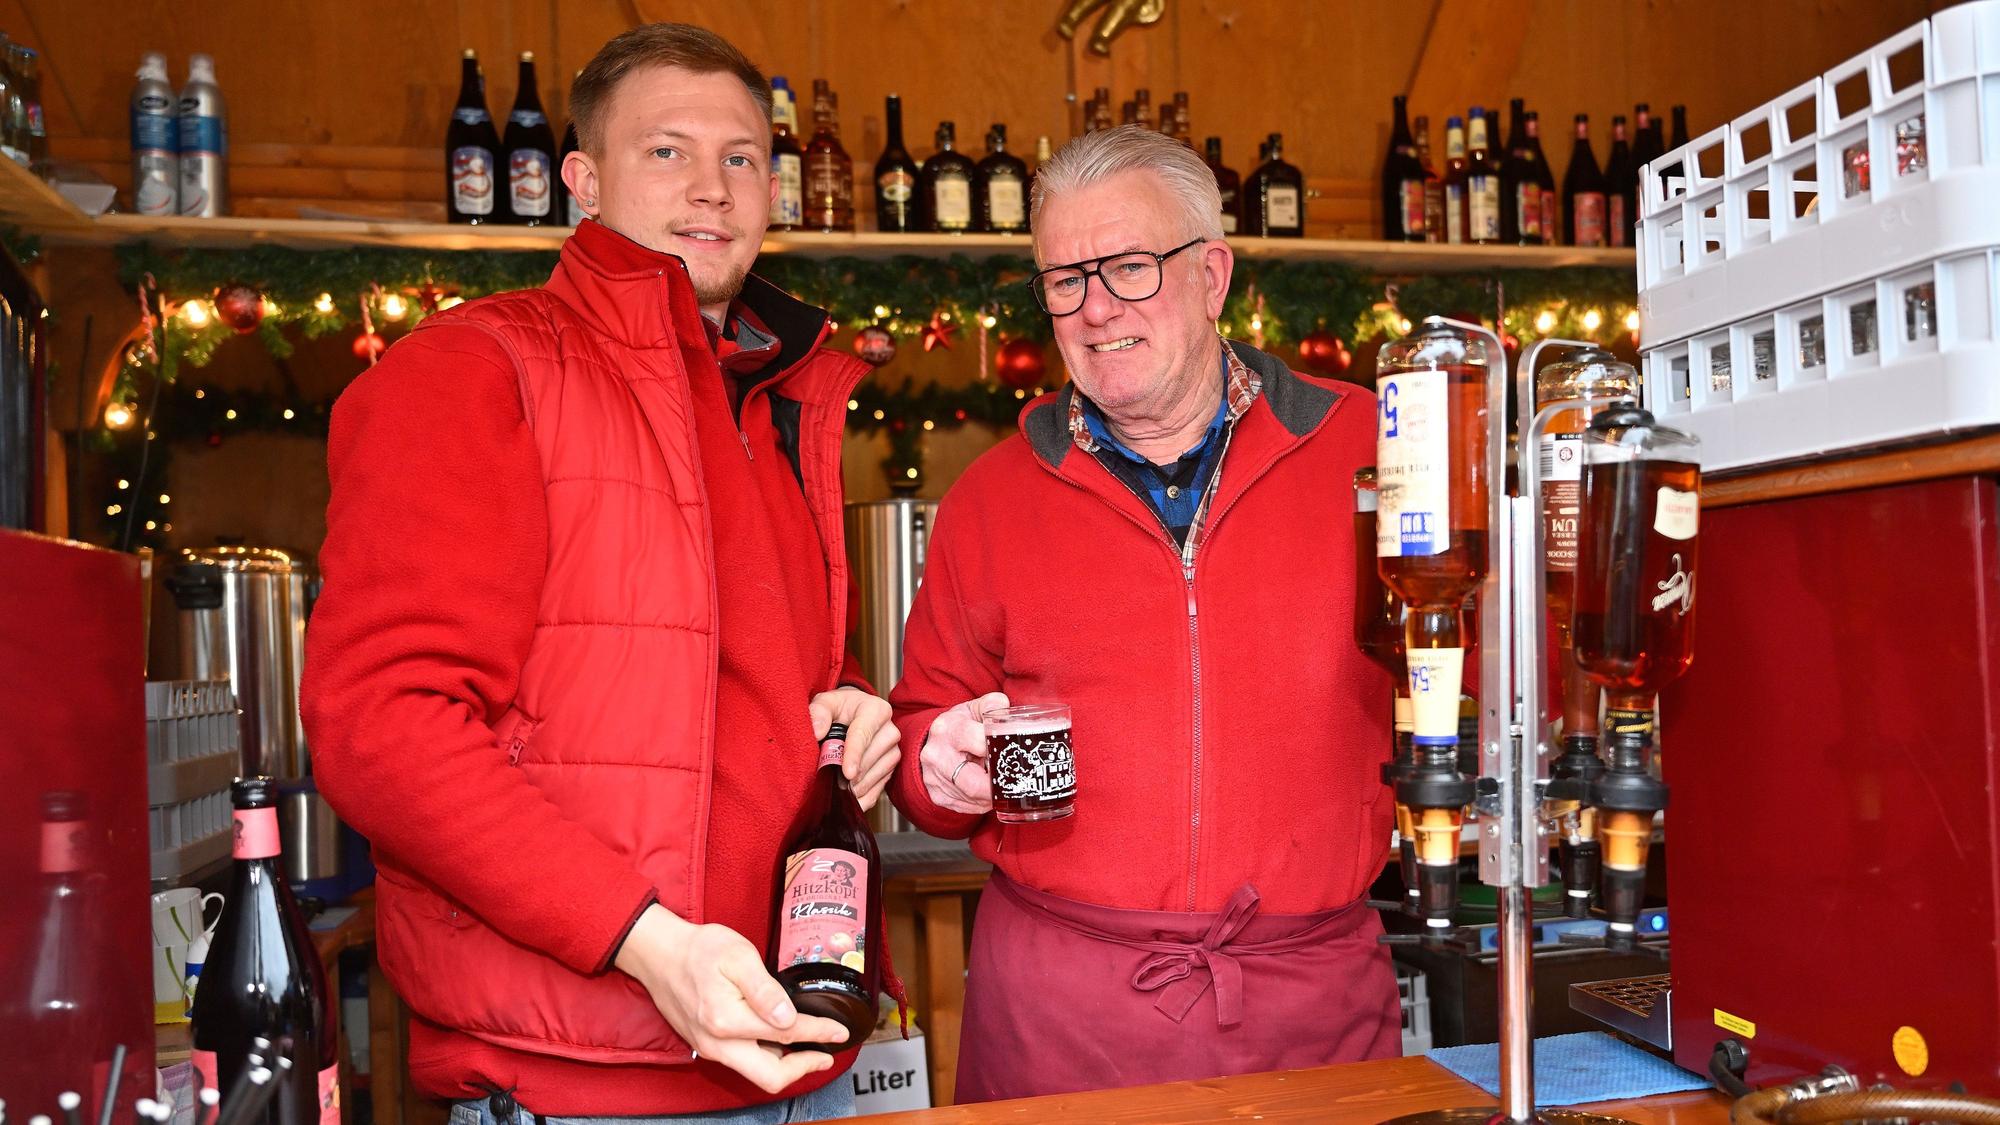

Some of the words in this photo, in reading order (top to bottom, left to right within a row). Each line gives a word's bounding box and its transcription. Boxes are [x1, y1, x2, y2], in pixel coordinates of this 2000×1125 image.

[1401, 514, 1434, 534] RUM
[1551, 518, 1578, 532] UM
[1411, 665, 1430, 692] 54
[792, 881, 858, 899] Hitzkopf
[792, 901, 852, 921] Klassik
[853, 1069, 916, 1096] Liter
